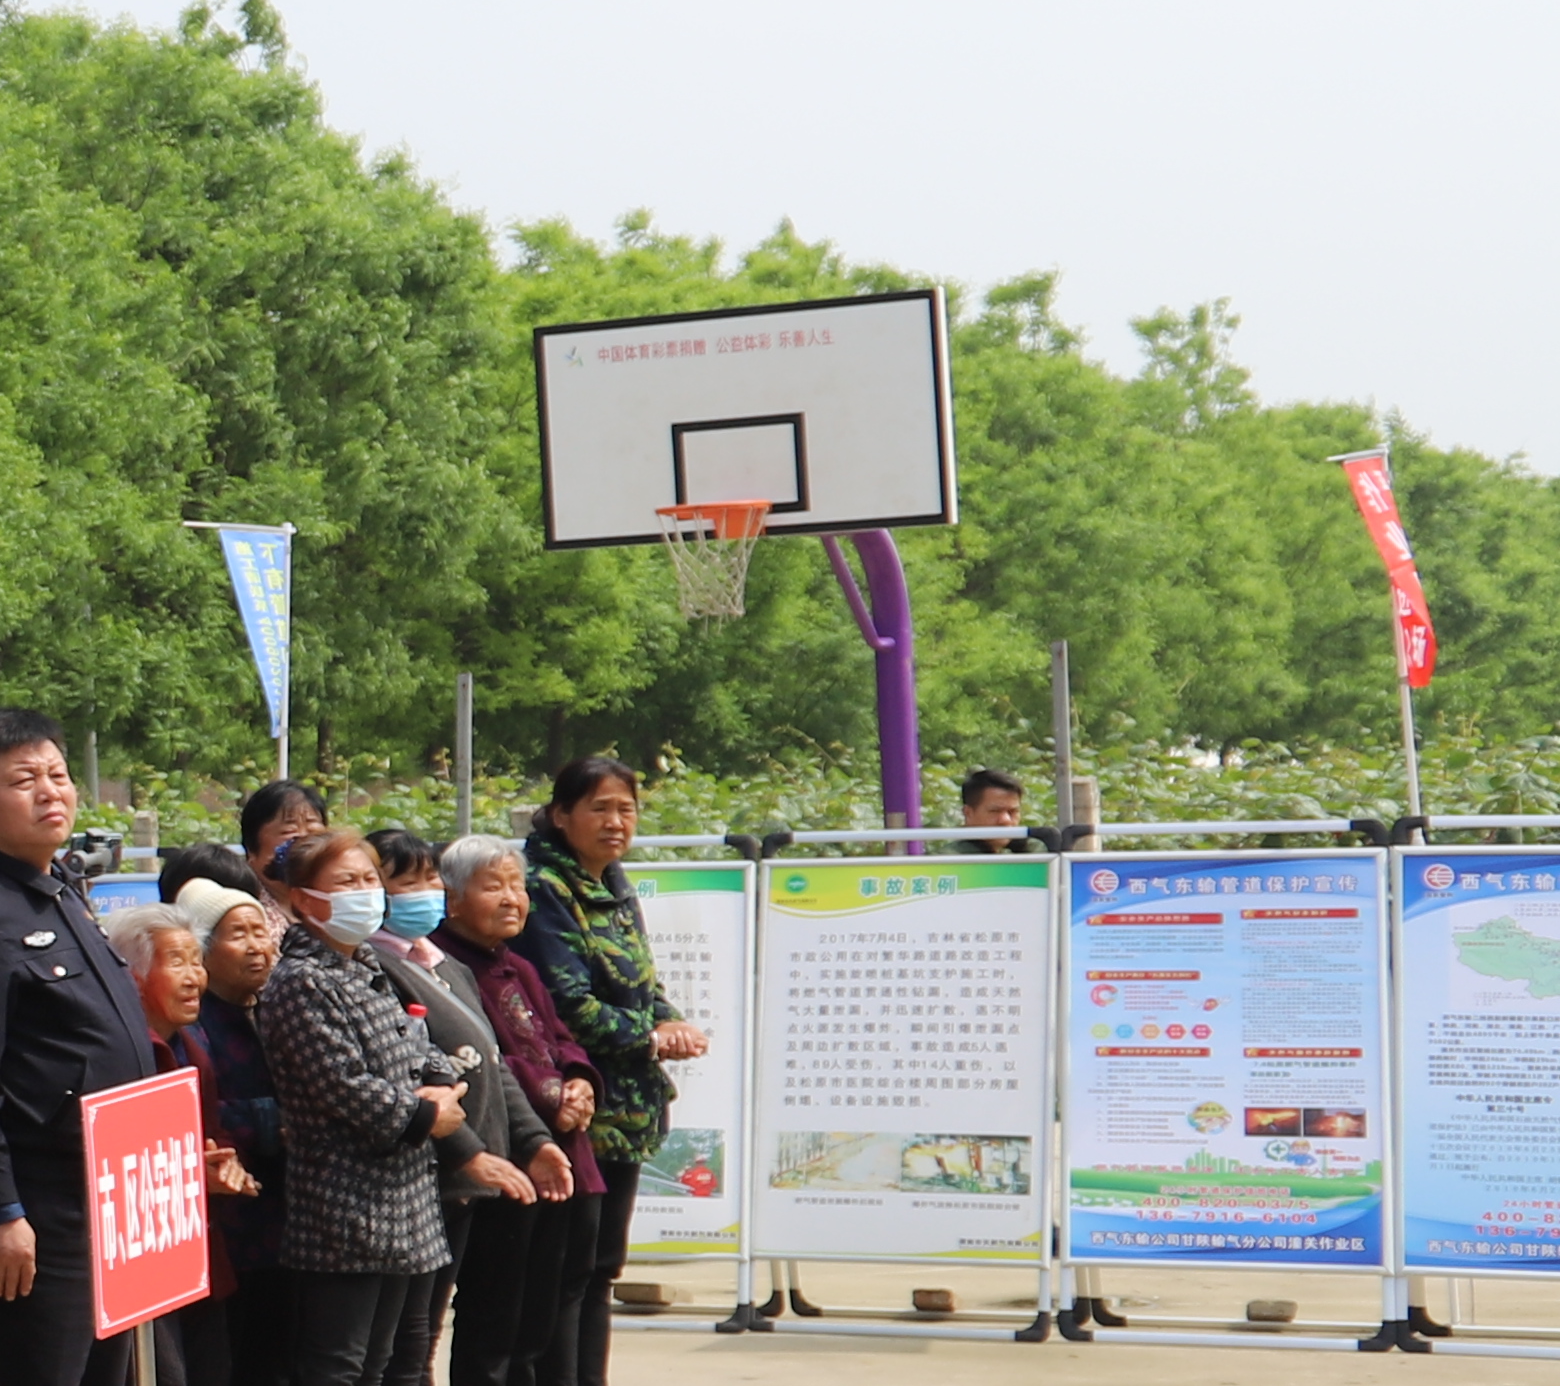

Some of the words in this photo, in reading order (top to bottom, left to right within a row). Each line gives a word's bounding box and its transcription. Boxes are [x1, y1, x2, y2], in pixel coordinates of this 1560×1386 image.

[597, 338, 707, 363] 中国体育彩票捐赠
[717, 331, 773, 354] 公益体彩
[778, 327, 836, 349] 乐善人生
[860, 875, 958, 896] 事故案例
[1128, 875, 1359, 895] 西气东输管道保护宣传
[97, 1132, 202, 1271] 市、区公安机关
[1089, 1231, 1366, 1252] 西气东输公司甘陕输气分公司潼关作业区
